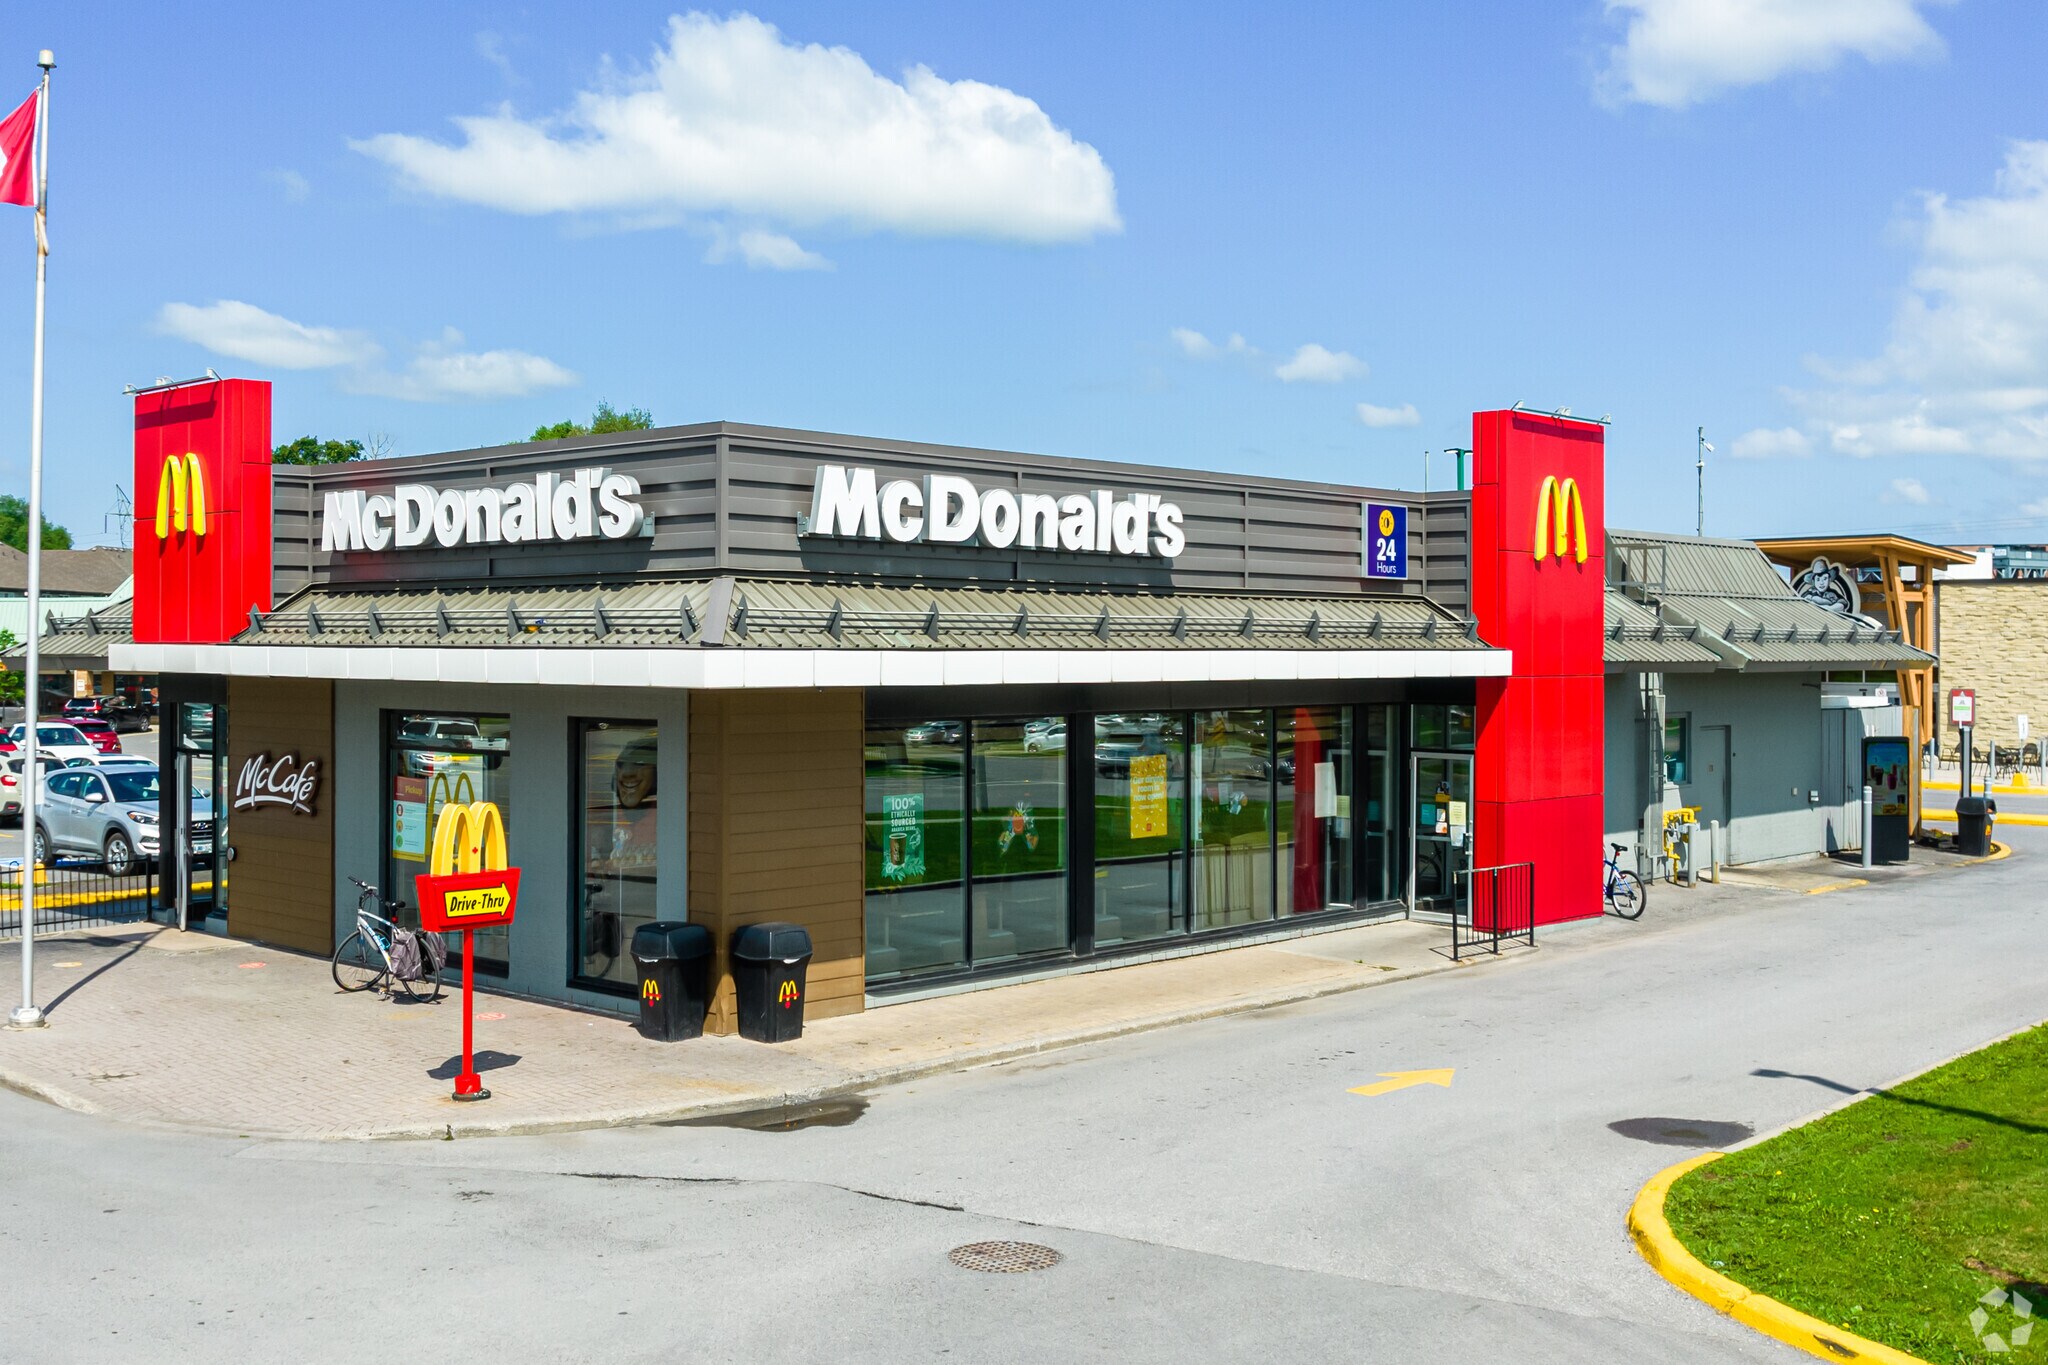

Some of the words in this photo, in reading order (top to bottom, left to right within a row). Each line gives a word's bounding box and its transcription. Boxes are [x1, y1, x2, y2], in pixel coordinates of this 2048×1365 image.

[322, 467, 644, 551] McDonald's
[808, 464, 1186, 558] McDonald's
[1376, 537, 1397, 562] 24
[1376, 562, 1397, 574] Hours
[235, 754, 315, 808] McCafé
[891, 796, 915, 810] 100%
[891, 810, 916, 819] ETHICALLY
[891, 817, 916, 827] SOURCED
[449, 893, 505, 912] Drive-Thru
